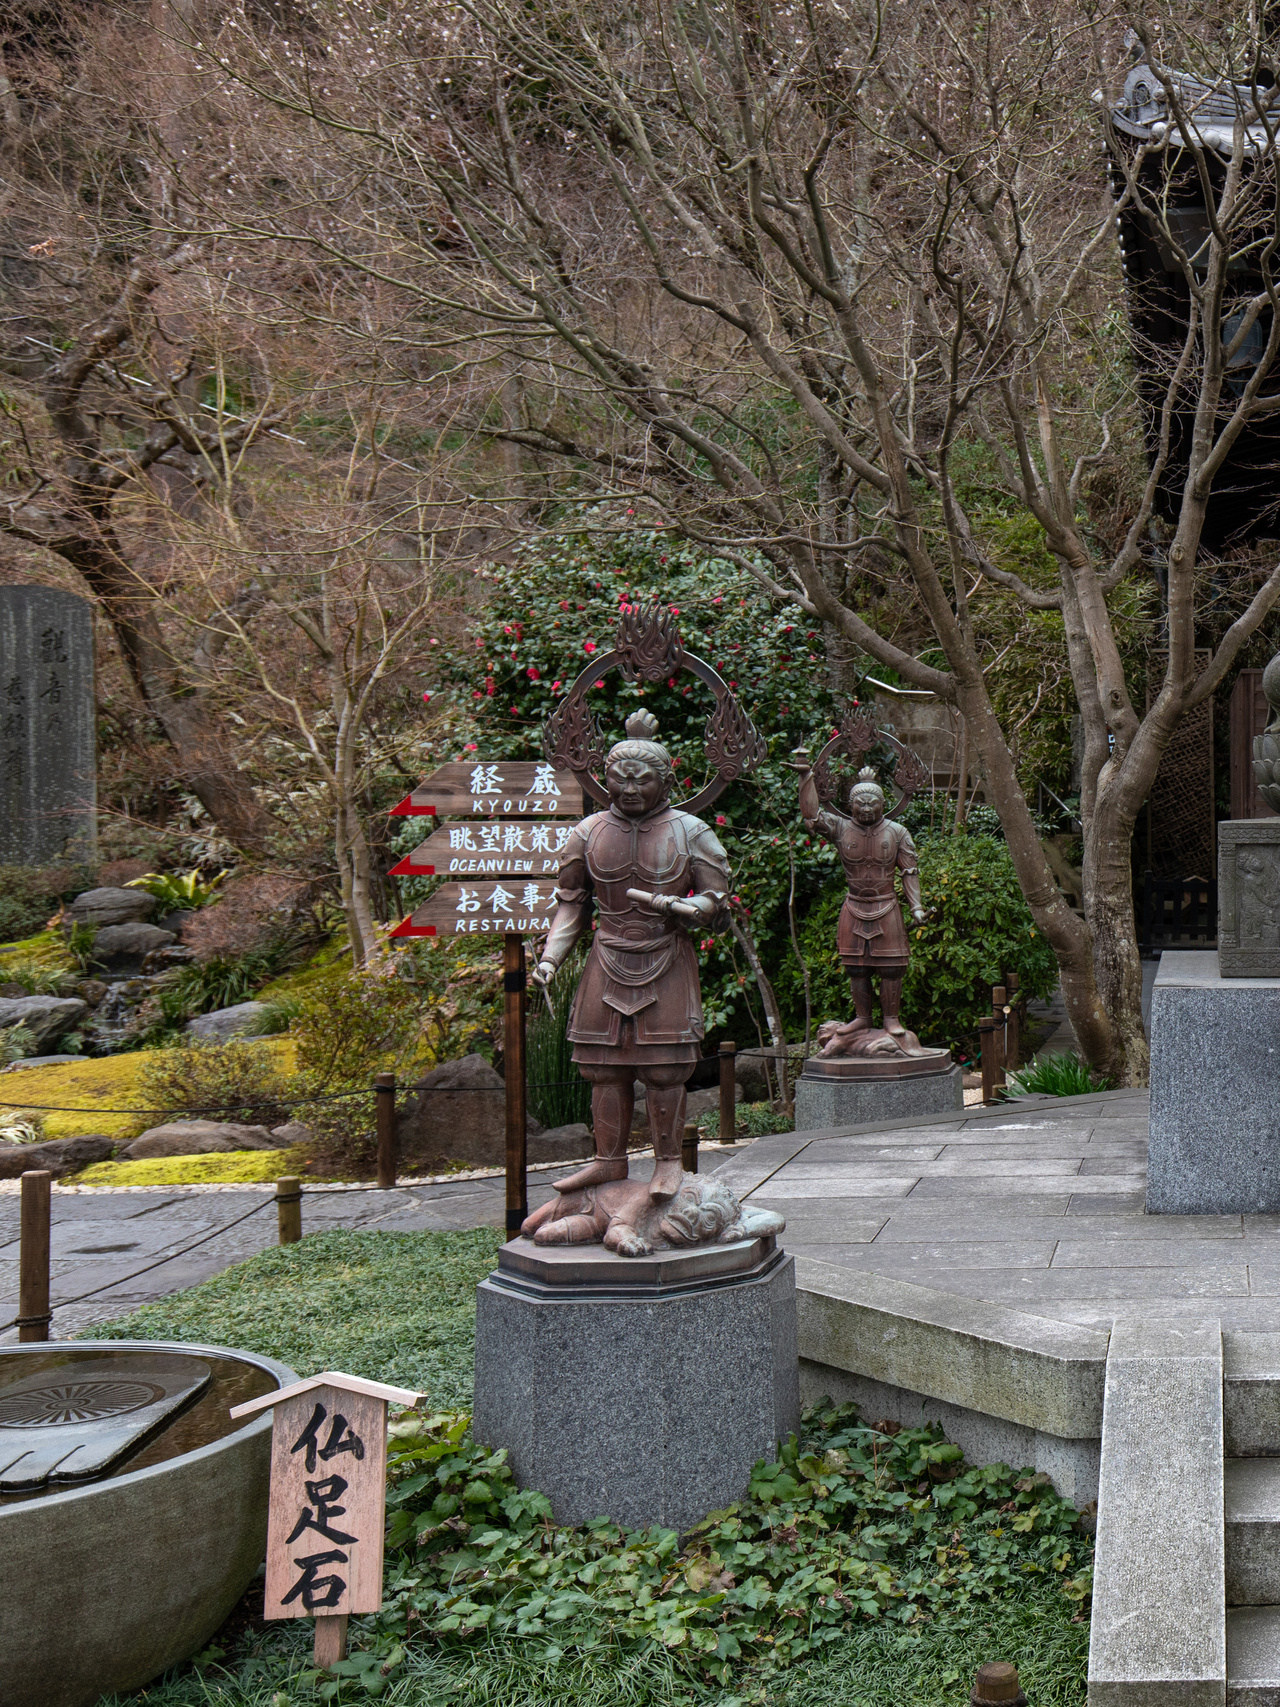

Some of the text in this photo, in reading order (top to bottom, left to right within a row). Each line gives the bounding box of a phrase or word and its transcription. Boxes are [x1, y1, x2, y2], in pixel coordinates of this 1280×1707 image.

[470, 764, 562, 796] 経蔵
[472, 799, 558, 812] KYOUZO
[449, 858, 534, 872] OCEANVIEW
[281, 1402, 364, 1610] 仏足石
